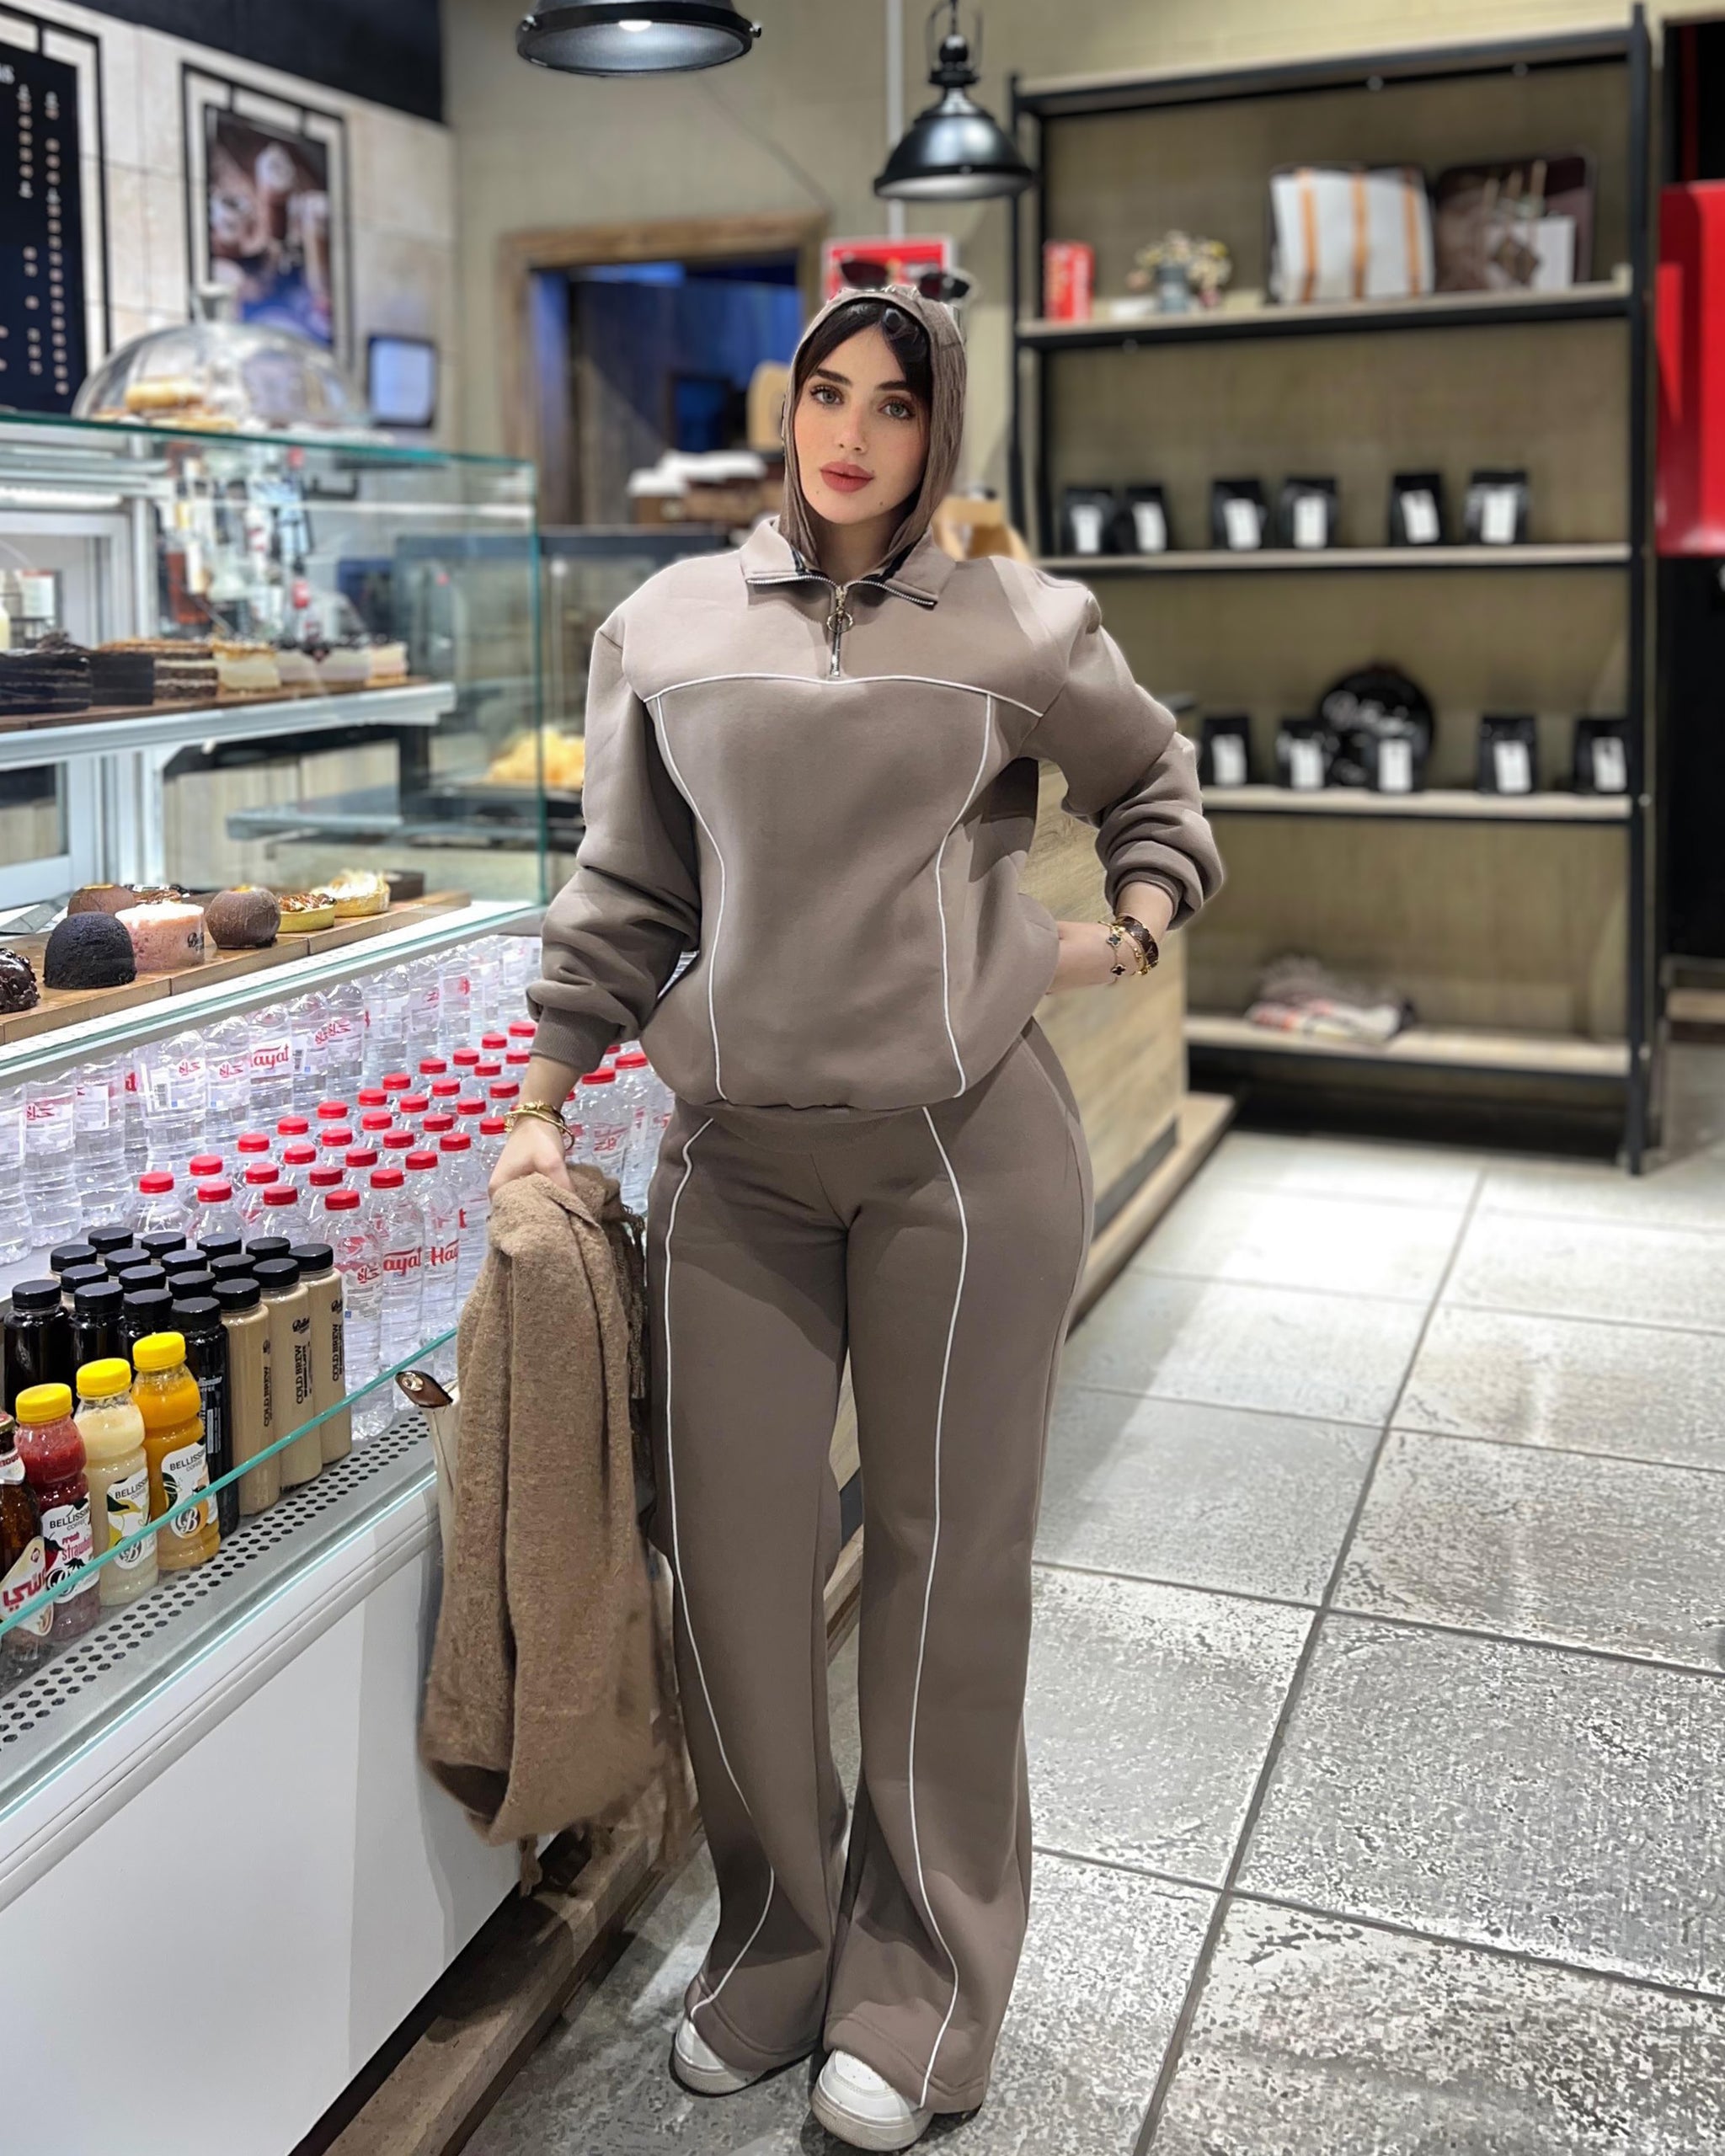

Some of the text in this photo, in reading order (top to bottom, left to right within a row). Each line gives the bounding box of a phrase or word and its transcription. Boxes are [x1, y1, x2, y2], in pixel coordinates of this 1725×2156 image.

[254, 1043, 290, 1070] ayat
[382, 1246, 422, 1277] ayat
[296, 1375, 304, 1405] COLD
